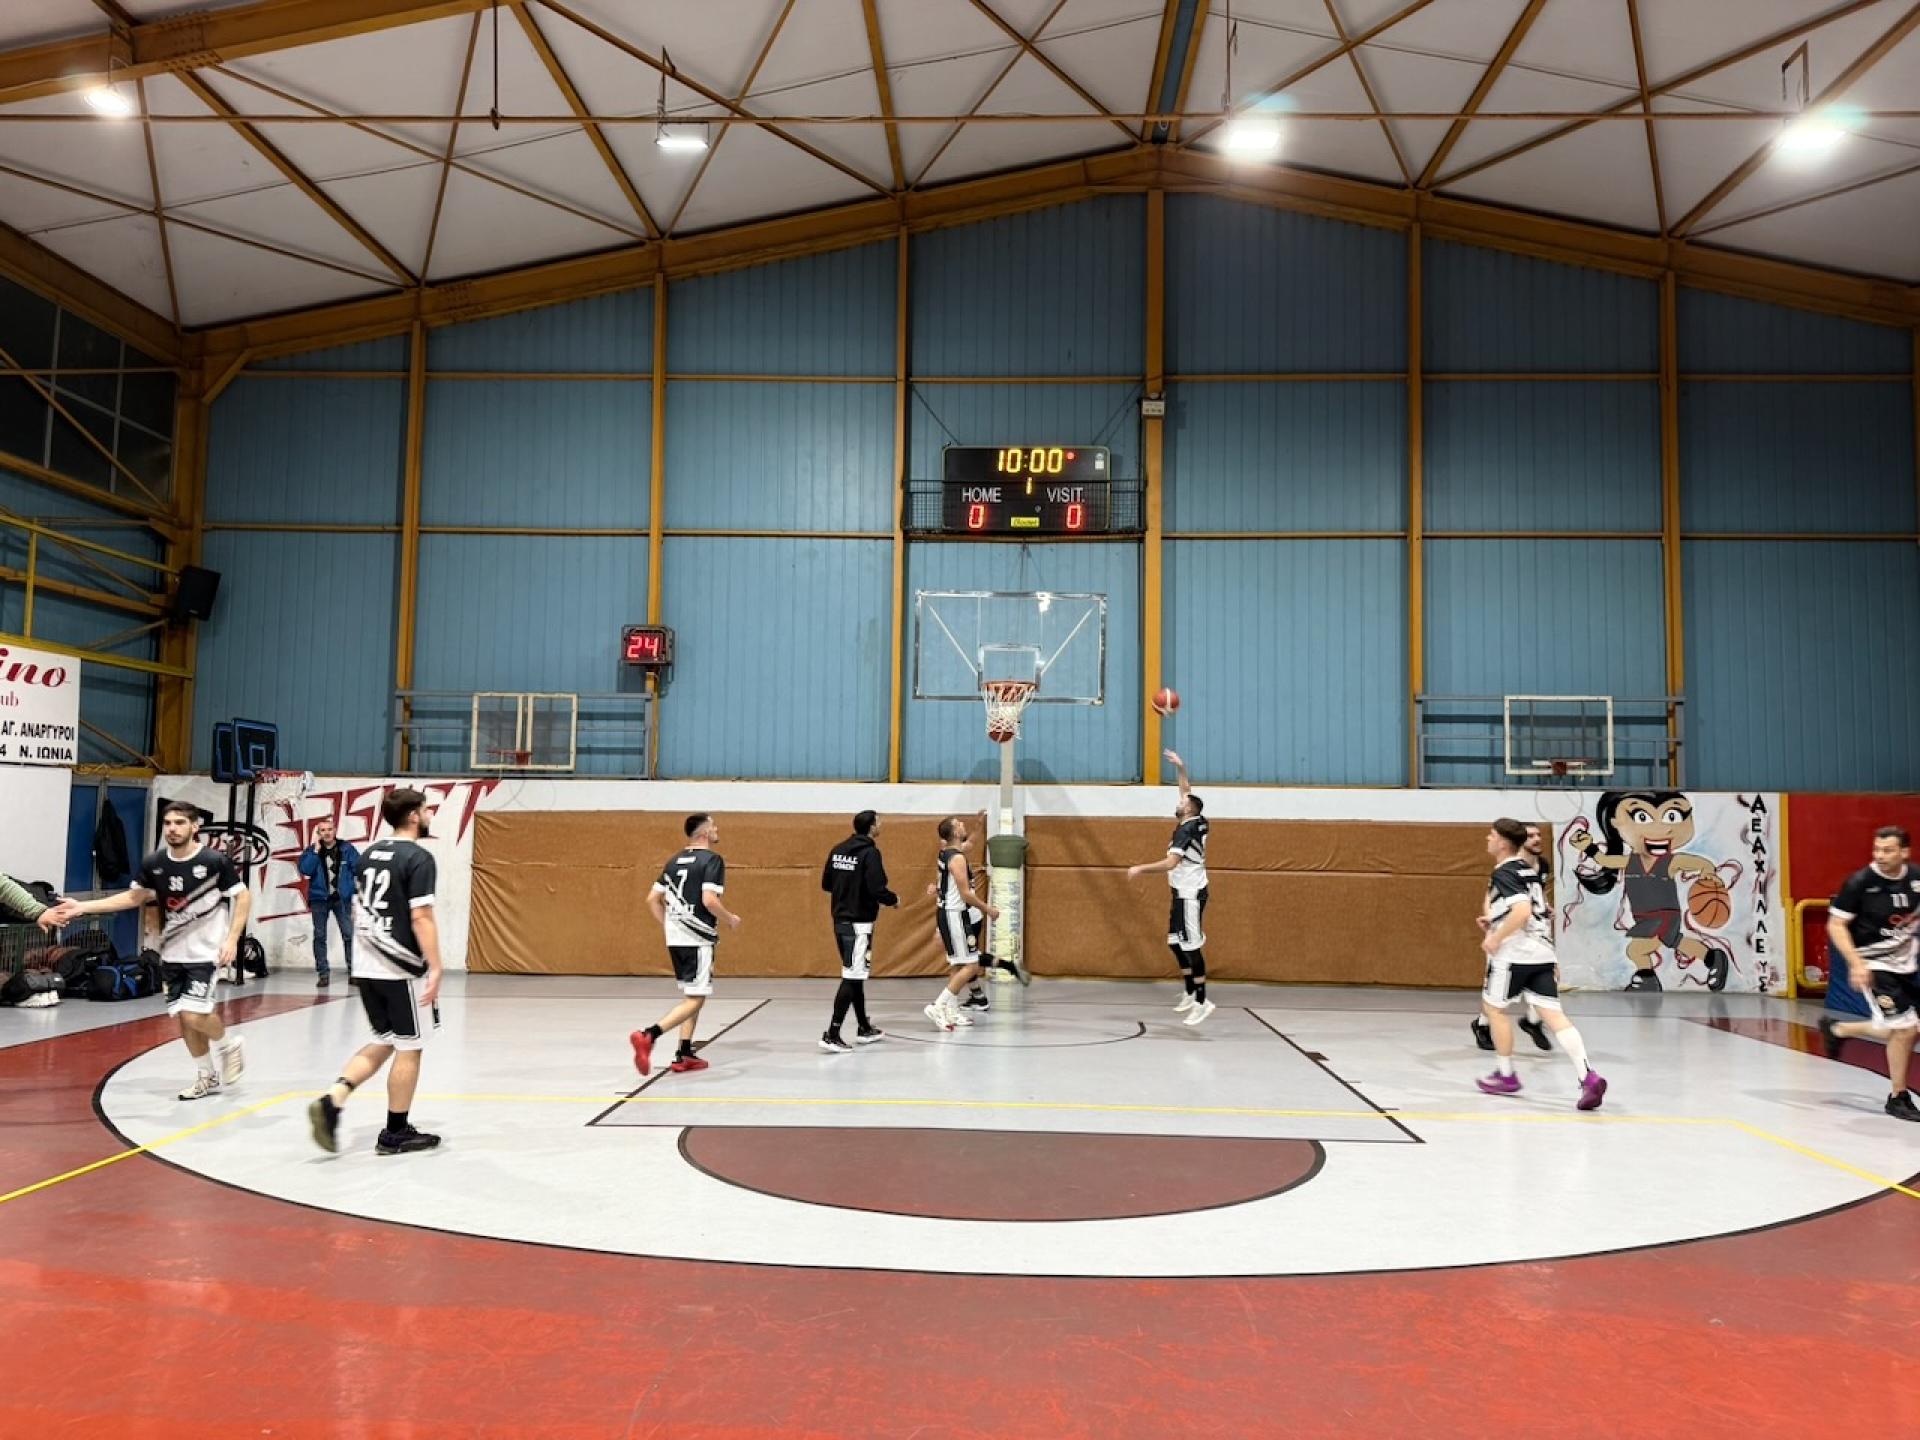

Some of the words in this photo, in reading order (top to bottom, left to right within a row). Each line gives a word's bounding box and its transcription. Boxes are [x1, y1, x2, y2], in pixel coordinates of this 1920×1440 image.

[998, 448, 1063, 473] 10:00
[962, 487, 1002, 503] HOME
[968, 504, 985, 529] 0
[1066, 504, 1082, 529] 0
[627, 635, 658, 658] 24
[1, 720, 17, 736] ΑΓ.
[20, 722, 75, 742] ΑΝΑΡΓΥΡΟΙ
[19, 745, 33, 758] Ν.
[37, 746, 73, 760] ΙΩΝΙΑ
[363, 867, 391, 909] 12
